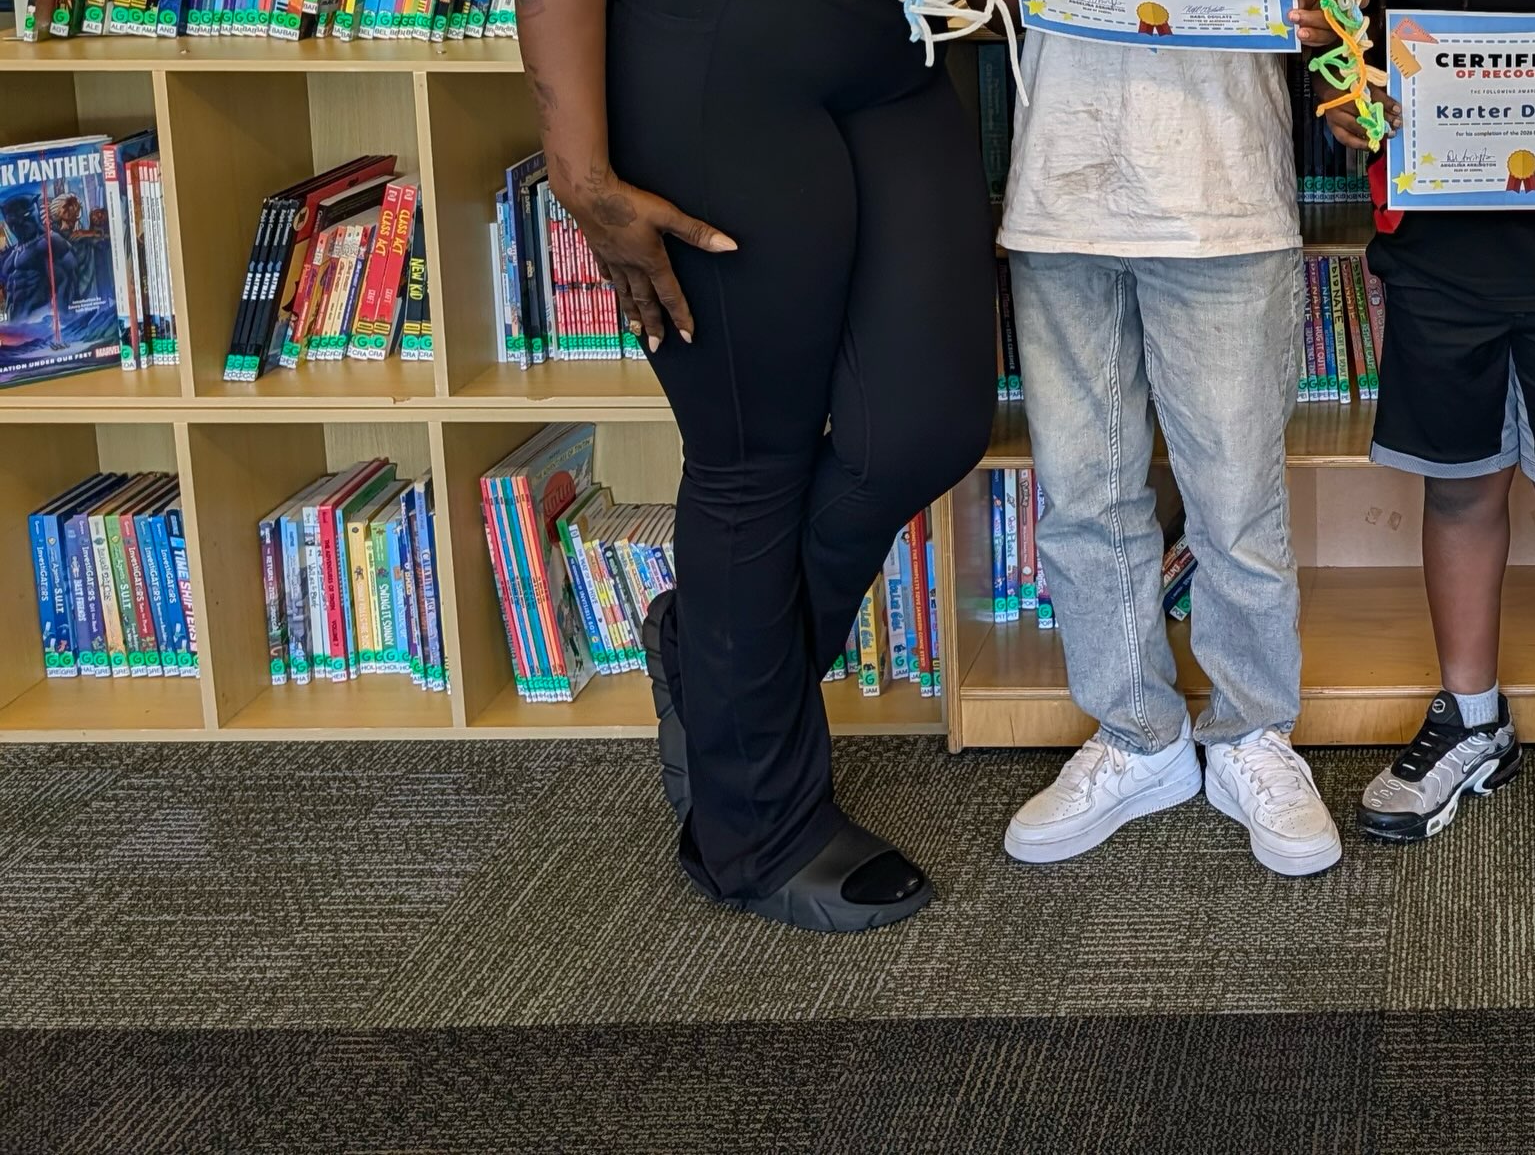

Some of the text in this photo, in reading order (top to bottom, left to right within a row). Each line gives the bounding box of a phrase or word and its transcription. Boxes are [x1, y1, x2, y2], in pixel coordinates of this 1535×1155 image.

[1456, 69, 1476, 79] OF
[1436, 104, 1512, 119] Karter
[17, 153, 102, 183] PANTHER
[104, 146, 116, 181] MARVEL
[375, 210, 393, 257] CLASS ACT
[392, 209, 410, 256] CLASS ACT
[409, 258, 424, 301] NEW KID
[28, 351, 92, 367] UNDER OUR FEET
[95, 345, 120, 358] MARVEL
[174, 549, 189, 582] TIME
